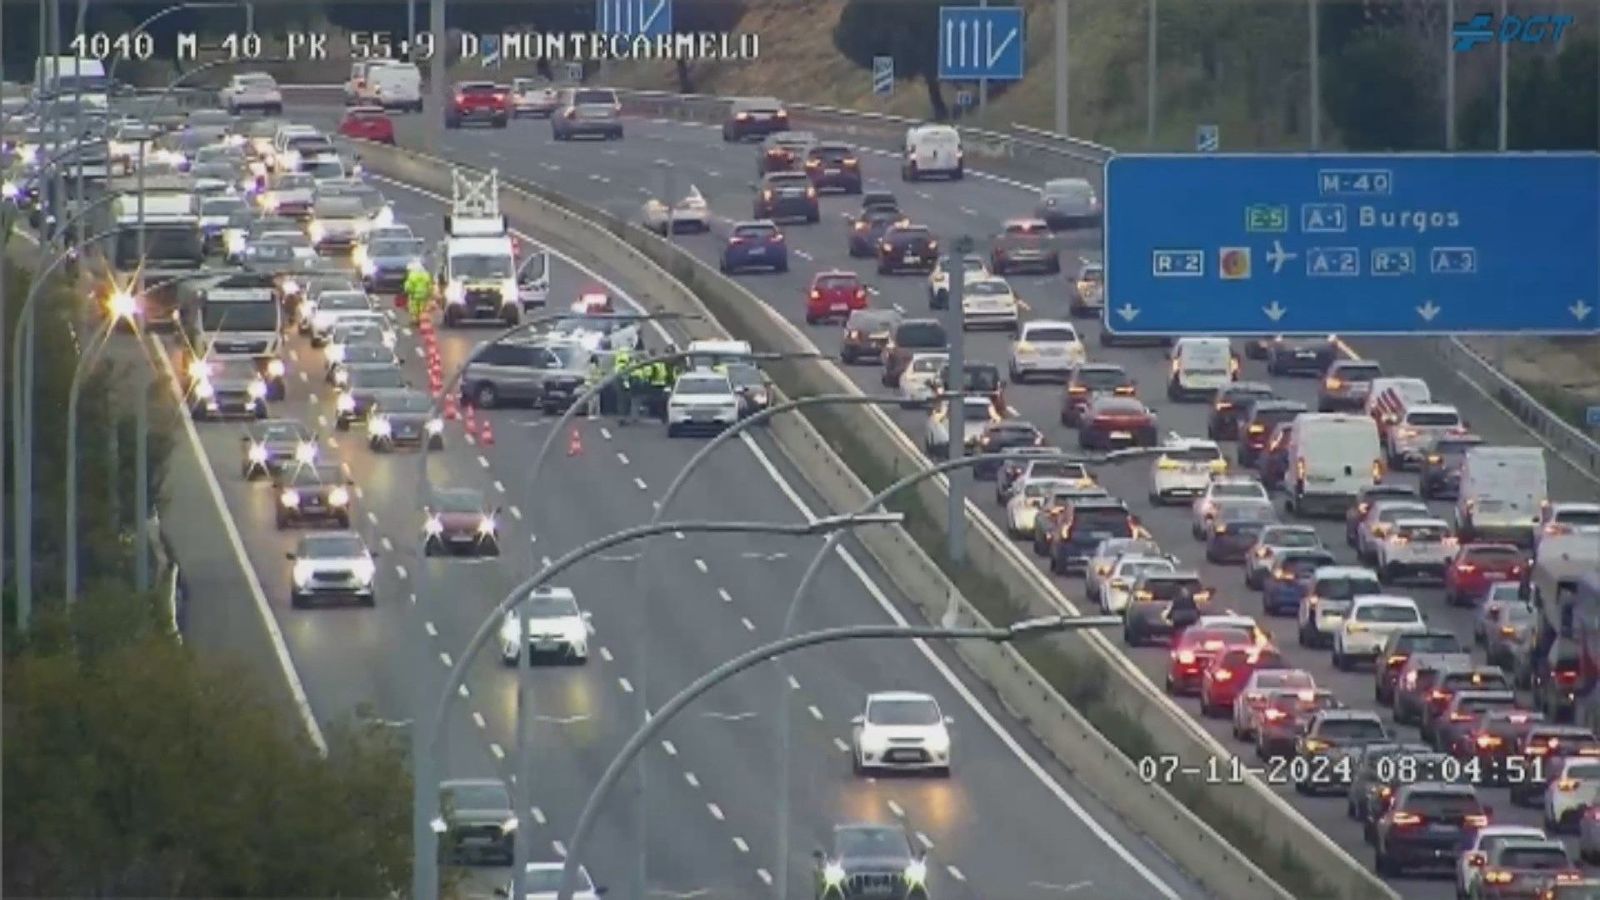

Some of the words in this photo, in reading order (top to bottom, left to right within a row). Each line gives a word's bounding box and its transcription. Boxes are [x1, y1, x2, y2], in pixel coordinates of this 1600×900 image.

[1322, 173, 1388, 192] M-40
[1250, 207, 1283, 227] E-5
[1307, 207, 1343, 227] A-1
[1359, 205, 1460, 233] Burgos
[1158, 254, 1199, 271] R-2
[1312, 252, 1352, 271] A-2
[1374, 252, 1410, 271] R-3
[1436, 252, 1473, 271] A-3
